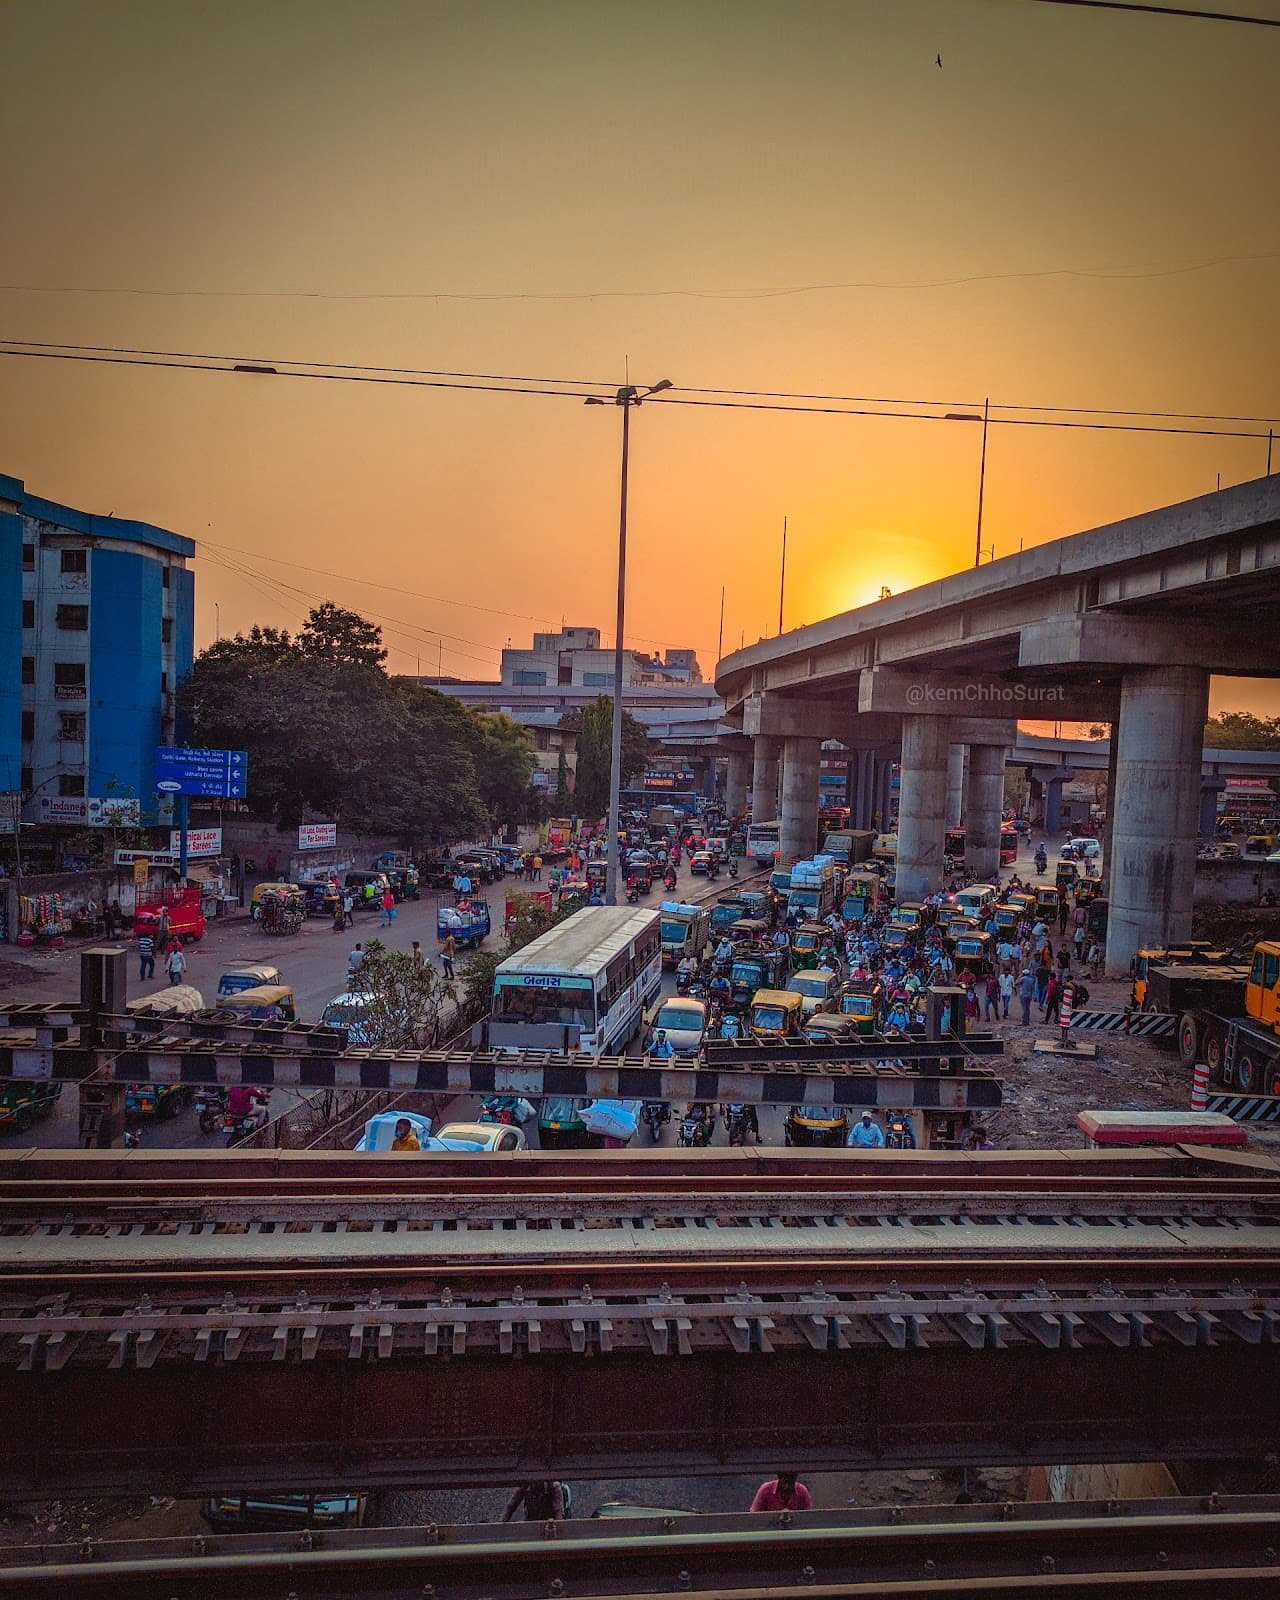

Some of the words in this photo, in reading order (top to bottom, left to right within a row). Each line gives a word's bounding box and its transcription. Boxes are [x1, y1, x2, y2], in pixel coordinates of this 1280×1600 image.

[203, 831, 217, 840] Lace
[192, 841, 212, 850] Sarees
[523, 976, 561, 986] બનાસ
